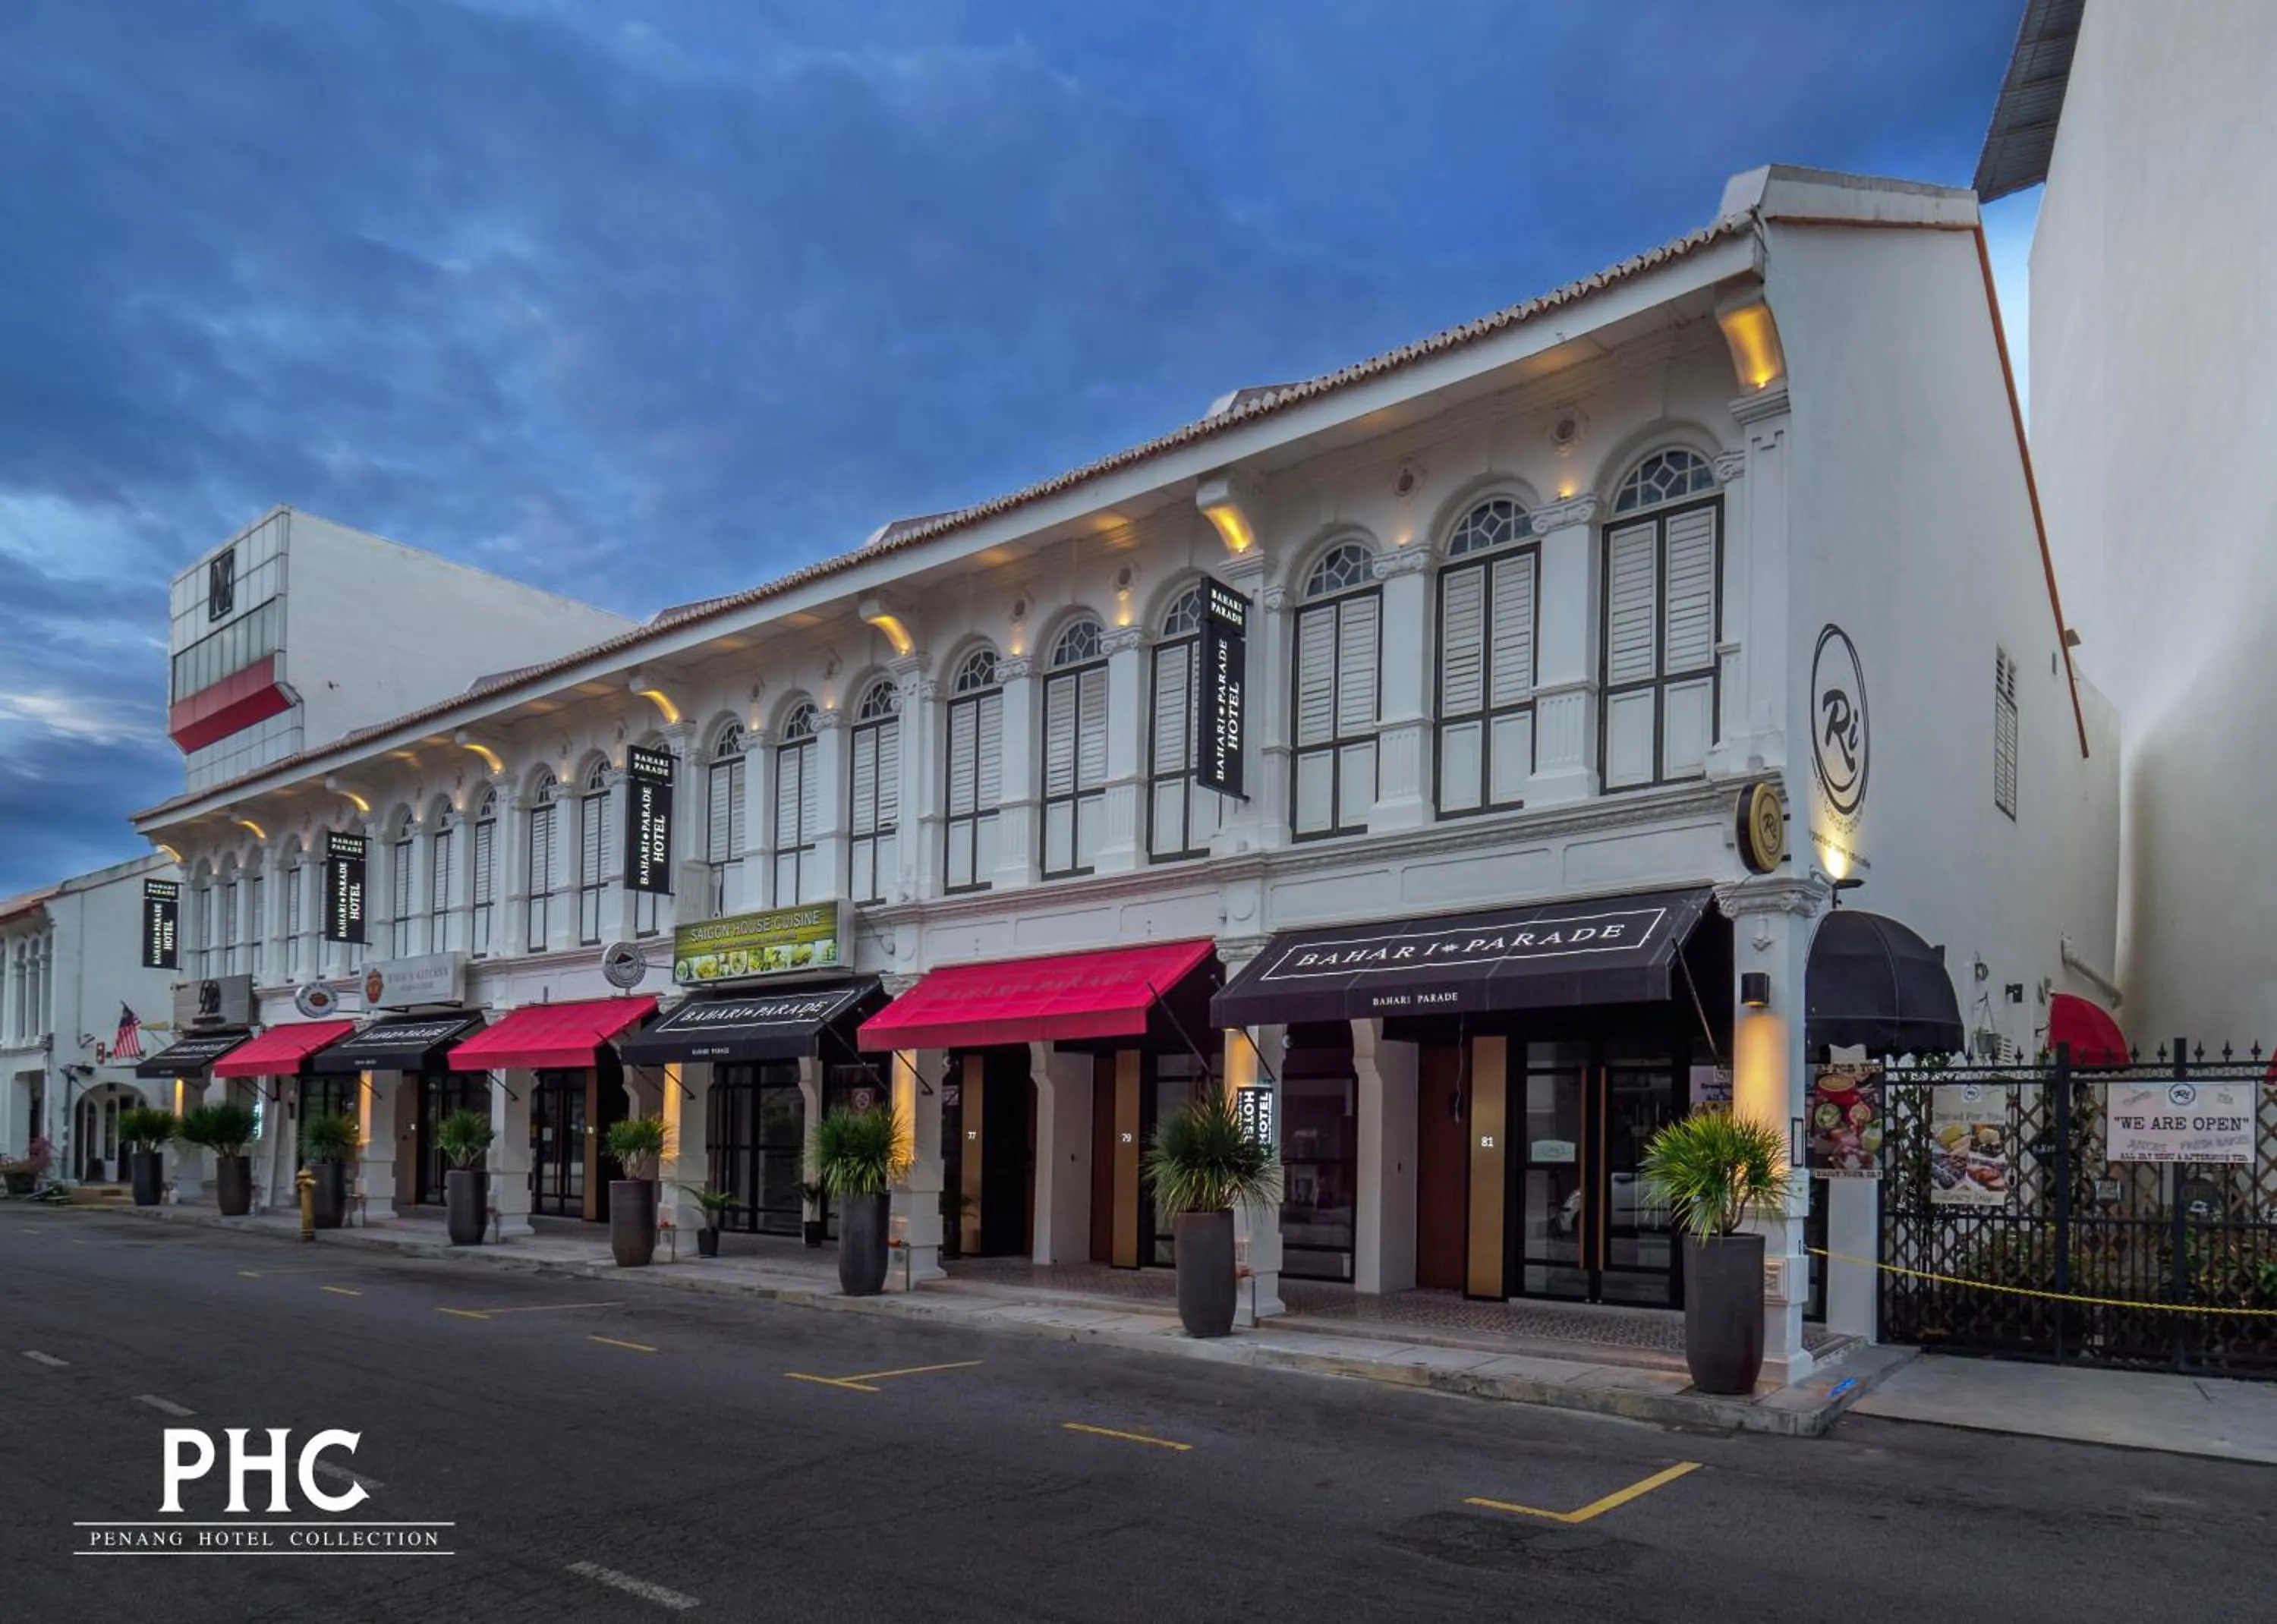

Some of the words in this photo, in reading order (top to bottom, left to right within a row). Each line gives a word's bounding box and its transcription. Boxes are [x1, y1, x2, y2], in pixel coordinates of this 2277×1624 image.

[1211, 587, 1242, 612] BAHARI
[1211, 603, 1242, 626] PARADE
[1217, 638, 1228, 706] PARADE
[1228, 681, 1239, 751] HOTEL
[1822, 689, 1858, 773] Ri
[634, 752, 669, 766] BAHARI
[1216, 718, 1226, 782] BAHARI
[633, 763, 669, 776] PARADE
[641, 786, 653, 832] PARADE
[653, 814, 666, 863] HOTEL
[339, 861, 348, 896] PARADE
[640, 841, 650, 886] BAHARI
[350, 883, 361, 921] HOTEL
[338, 904, 347, 938] BAHARI
[691, 924, 729, 943] SAIGON
[732, 917, 771, 936] HOUSE
[773, 910, 821, 930] CUISINE
[1295, 943, 1443, 968] BAHARI
[1461, 923, 1627, 954] PARADE
[680, 1008, 745, 1021] BAHARI
[752, 1000, 828, 1016] PARADE
[1372, 995, 1411, 1006] BAHARI
[1416, 992, 1458, 1004] PARADE
[2114, 1116, 2144, 1130] "WE
[2150, 1116, 2187, 1130] ARE
[2193, 1116, 2250, 1131] OPEN"
[1481, 1136, 1494, 1147] 81
